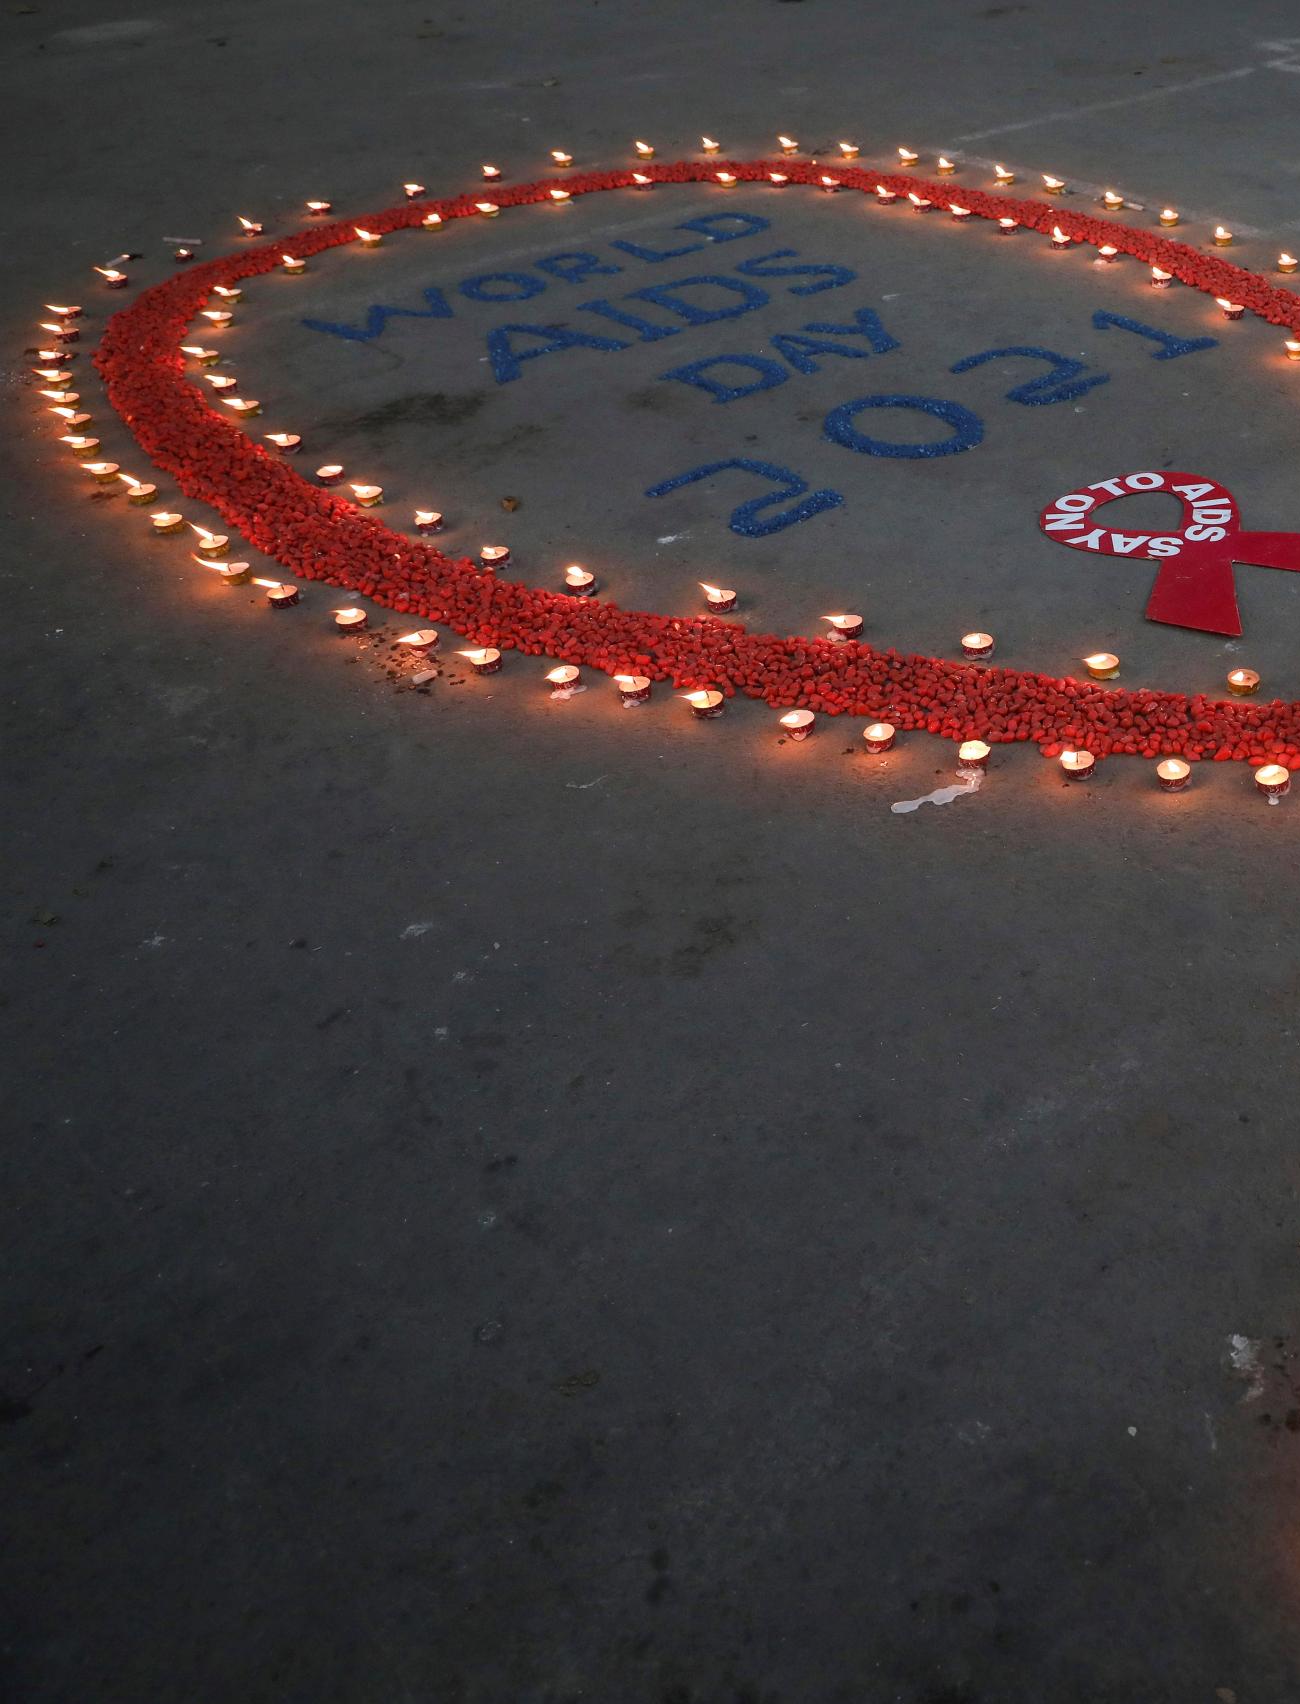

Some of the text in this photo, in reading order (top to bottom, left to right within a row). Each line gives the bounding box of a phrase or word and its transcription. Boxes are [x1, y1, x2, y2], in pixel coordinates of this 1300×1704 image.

[303, 211, 771, 341] WORLD
[487, 248, 858, 383] AIDS
[660, 307, 901, 404] DAY
[644, 309, 1219, 539] 2021
[1045, 472, 1232, 557] SAY NO TO AIDS
